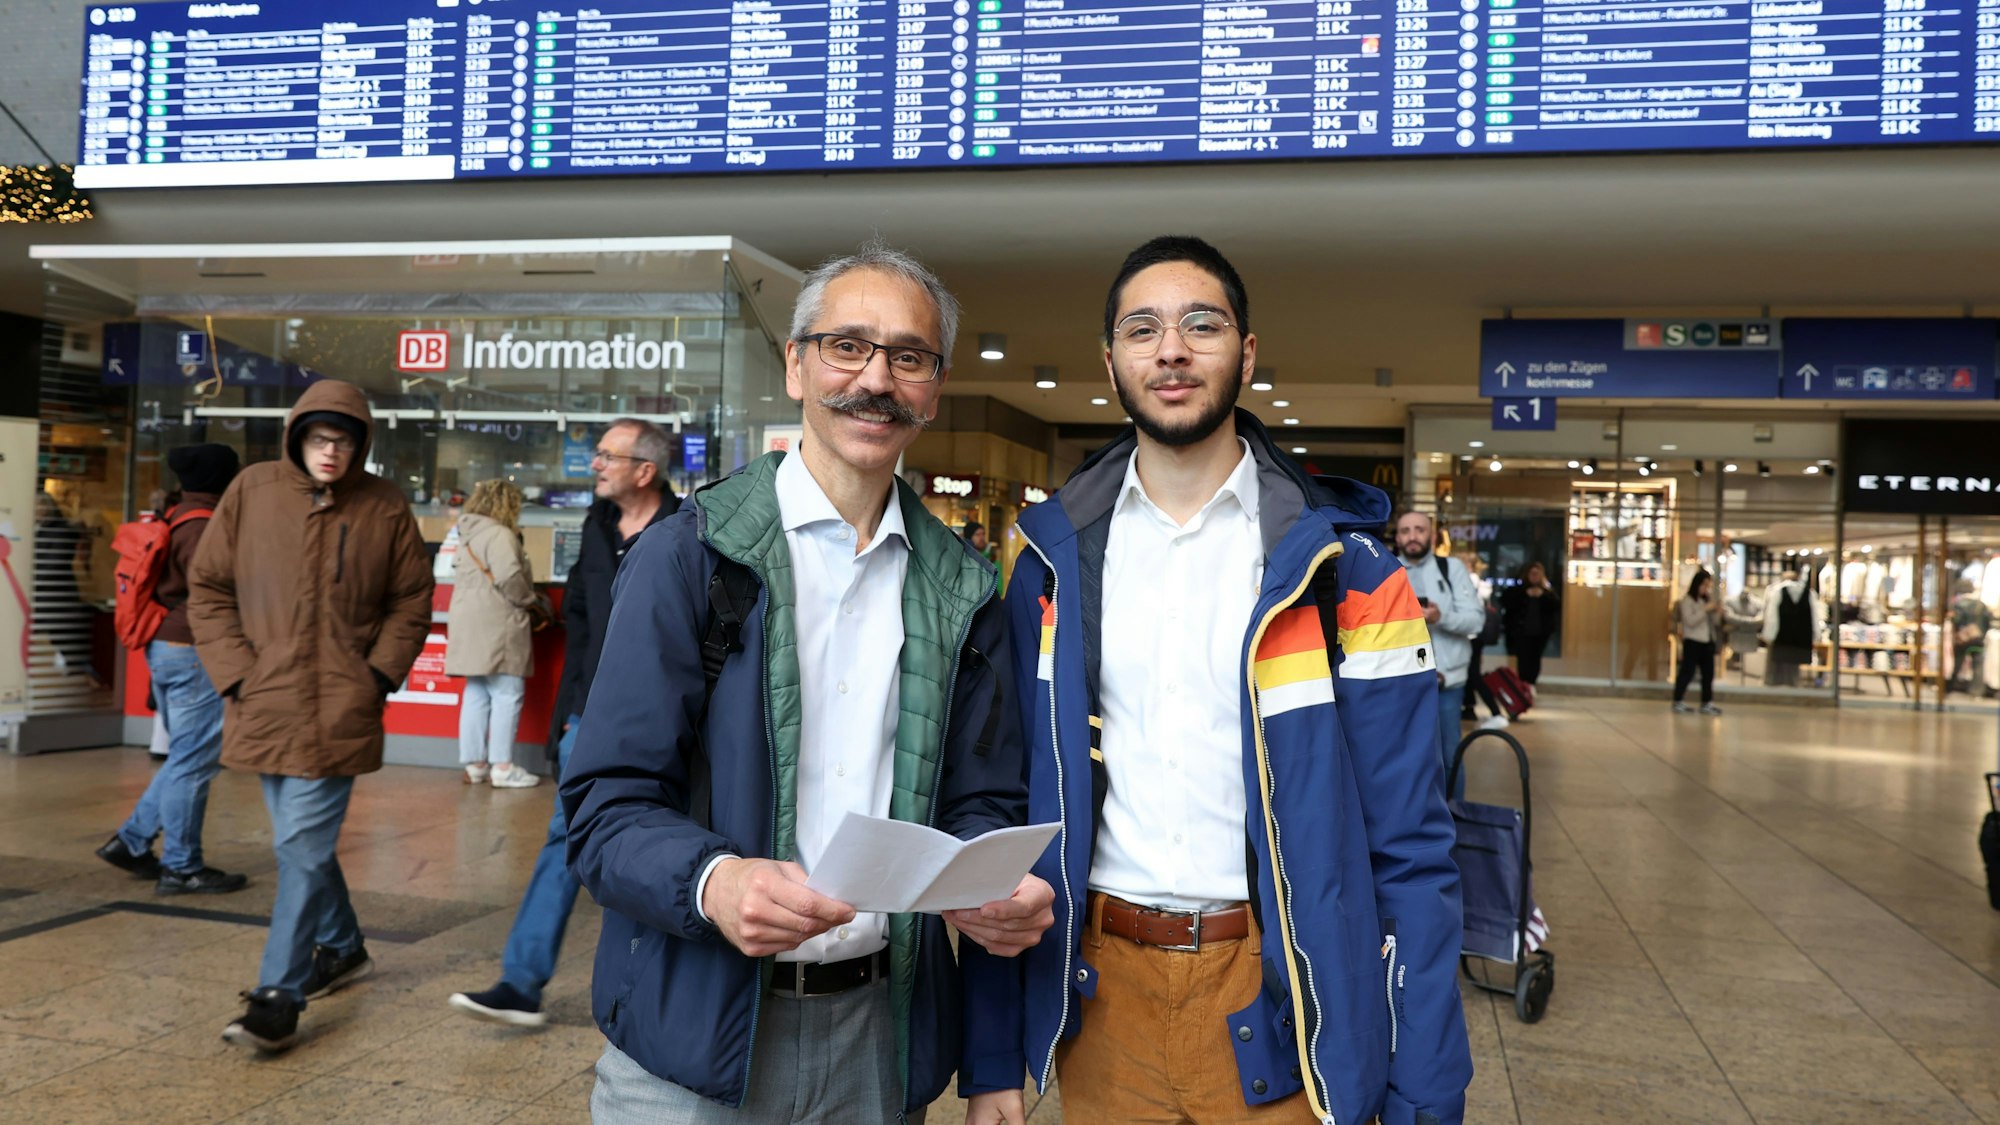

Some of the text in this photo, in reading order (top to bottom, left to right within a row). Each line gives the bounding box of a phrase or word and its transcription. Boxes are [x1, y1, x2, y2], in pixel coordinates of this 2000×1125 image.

[1317, 3, 1332, 16] 10
[1316, 22, 1331, 34] 11
[1884, 17, 1901, 31] 11
[1315, 60, 1329, 72] 11
[1882, 59, 1900, 73] 11
[1314, 78, 1329, 91] 10
[1314, 98, 1328, 110] 11
[1881, 100, 1898, 114] 11
[1881, 121, 1898, 134] 11
[1313, 136, 1327, 148] 10
[402, 333, 685, 369] DB Information
[1527, 360, 1608, 375] zu den Zügen
[1526, 376, 1594, 389] koelnmesse
[1528, 398, 1540, 420] 1
[933, 476, 972, 497] Stop
